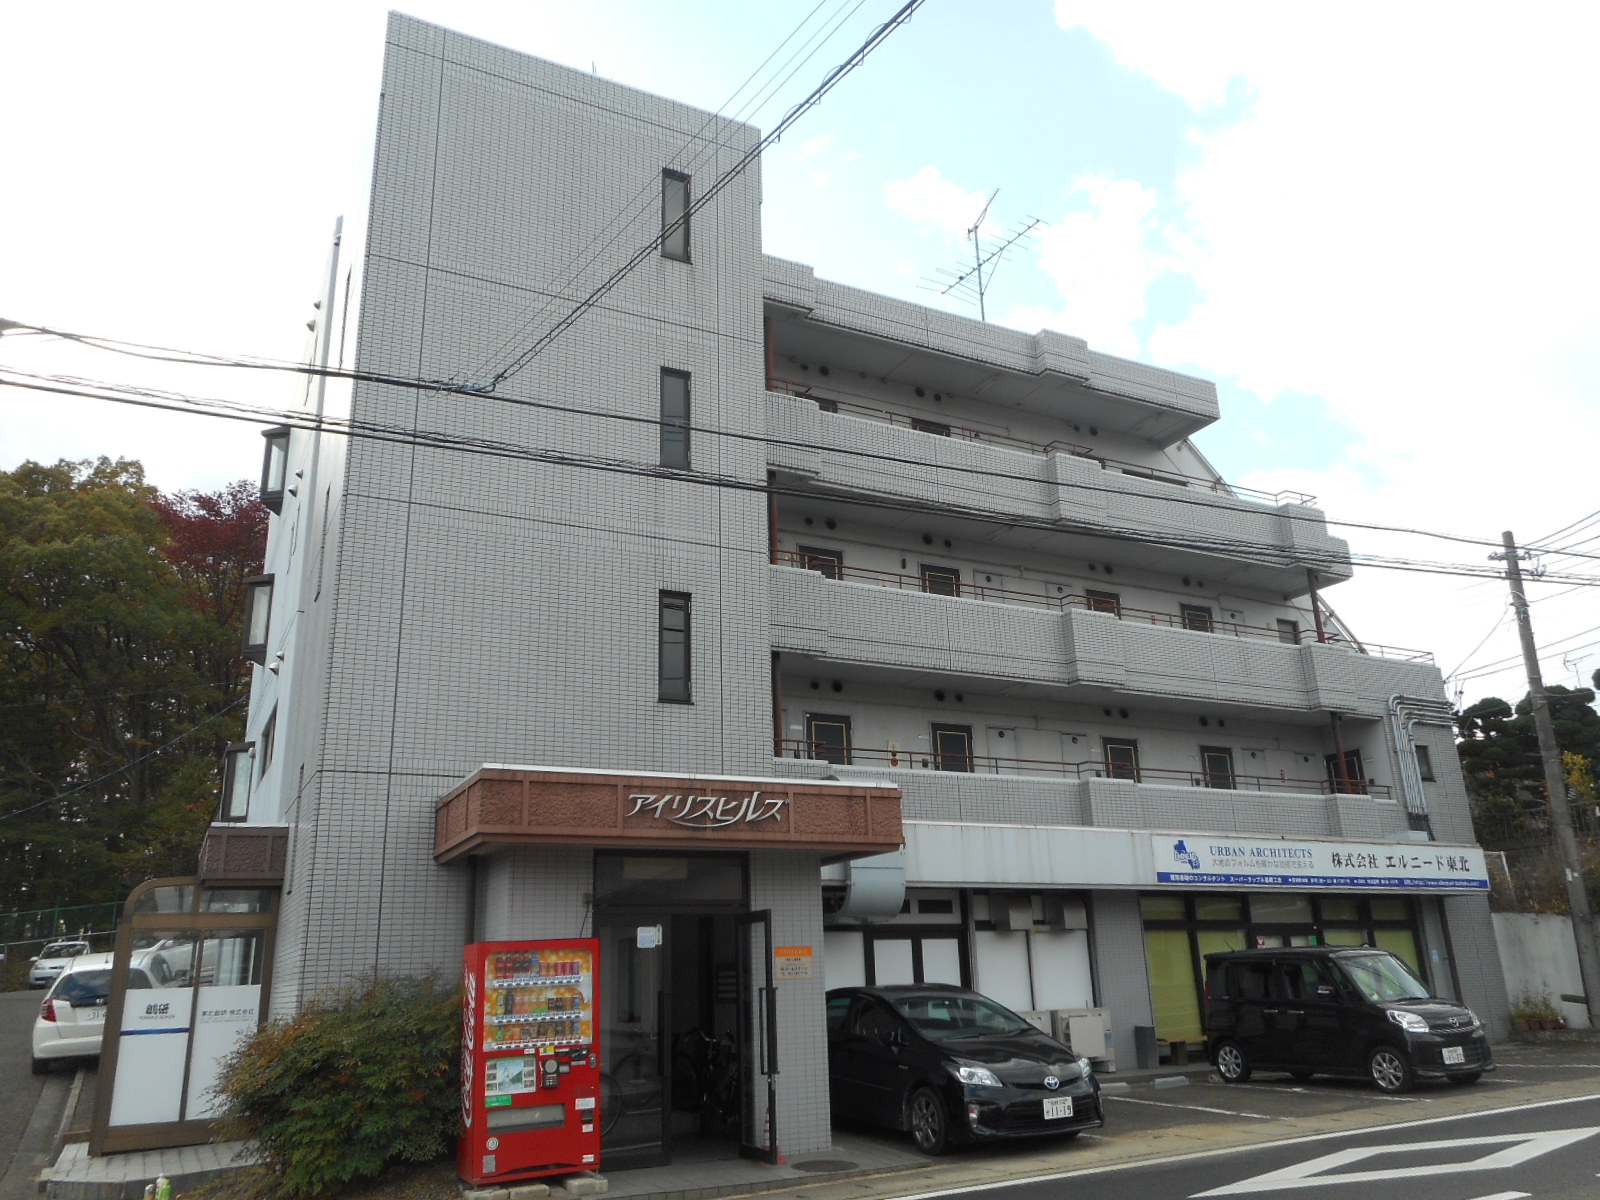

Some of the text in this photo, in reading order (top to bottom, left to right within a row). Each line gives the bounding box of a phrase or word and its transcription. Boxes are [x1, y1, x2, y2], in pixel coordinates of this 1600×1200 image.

[624, 791, 789, 827] アイリスヒルズ
[1209, 845, 1313, 859] URBAN ARCHITECTS
[1331, 852, 1470, 872] 株式会社 エルニード東北
